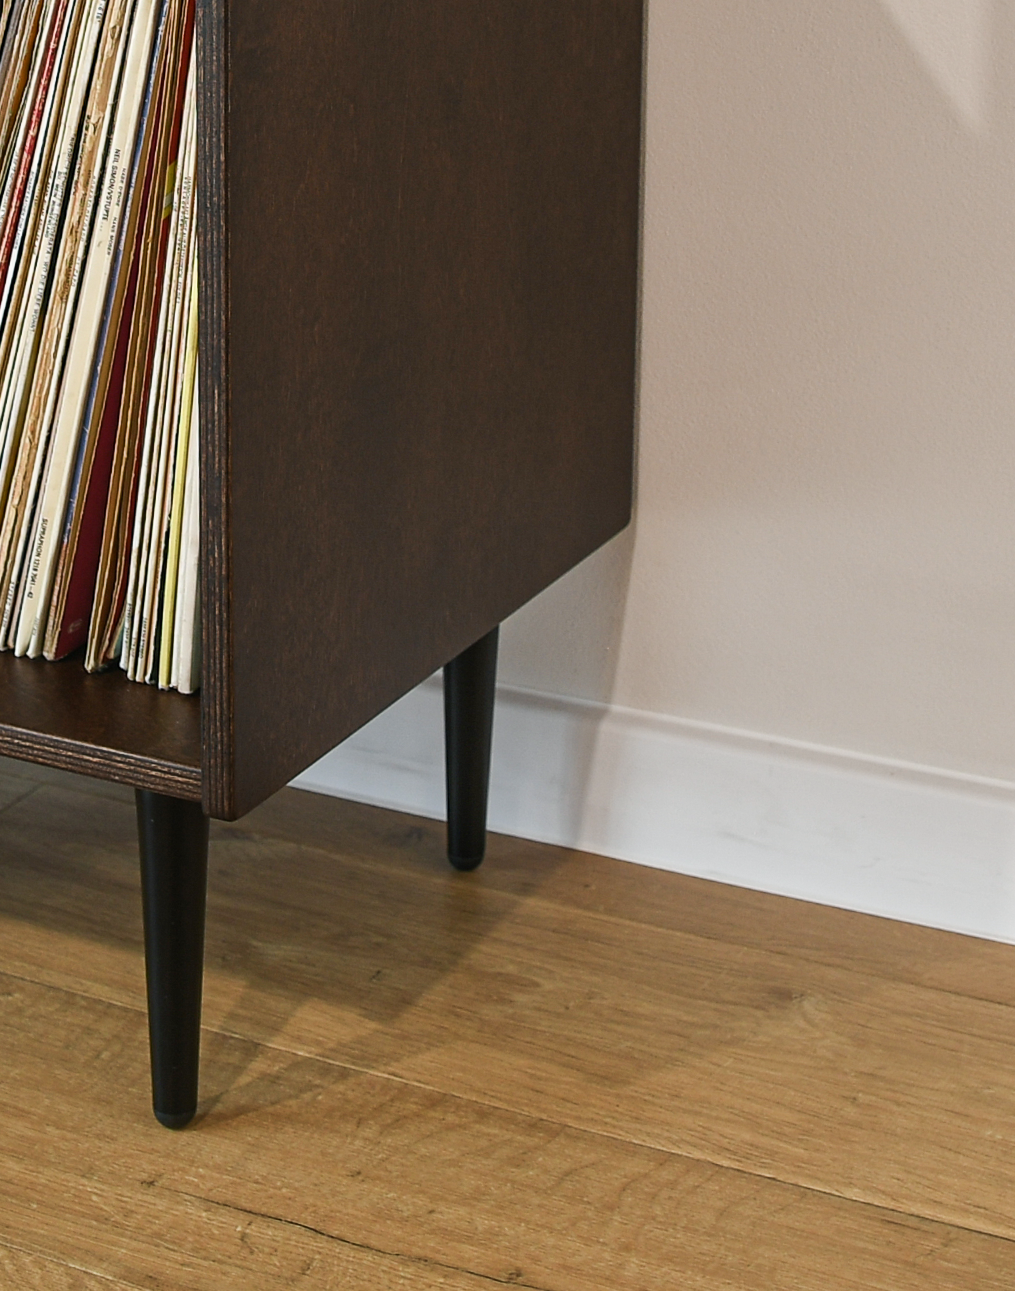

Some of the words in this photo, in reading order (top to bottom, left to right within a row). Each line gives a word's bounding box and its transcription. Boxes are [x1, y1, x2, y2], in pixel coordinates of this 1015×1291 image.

[112, 148, 121, 164] NEIL
[105, 234, 114, 256] MOSER
[34, 517, 48, 557] SUPRAPHON
[32, 557, 40, 572] 1218
